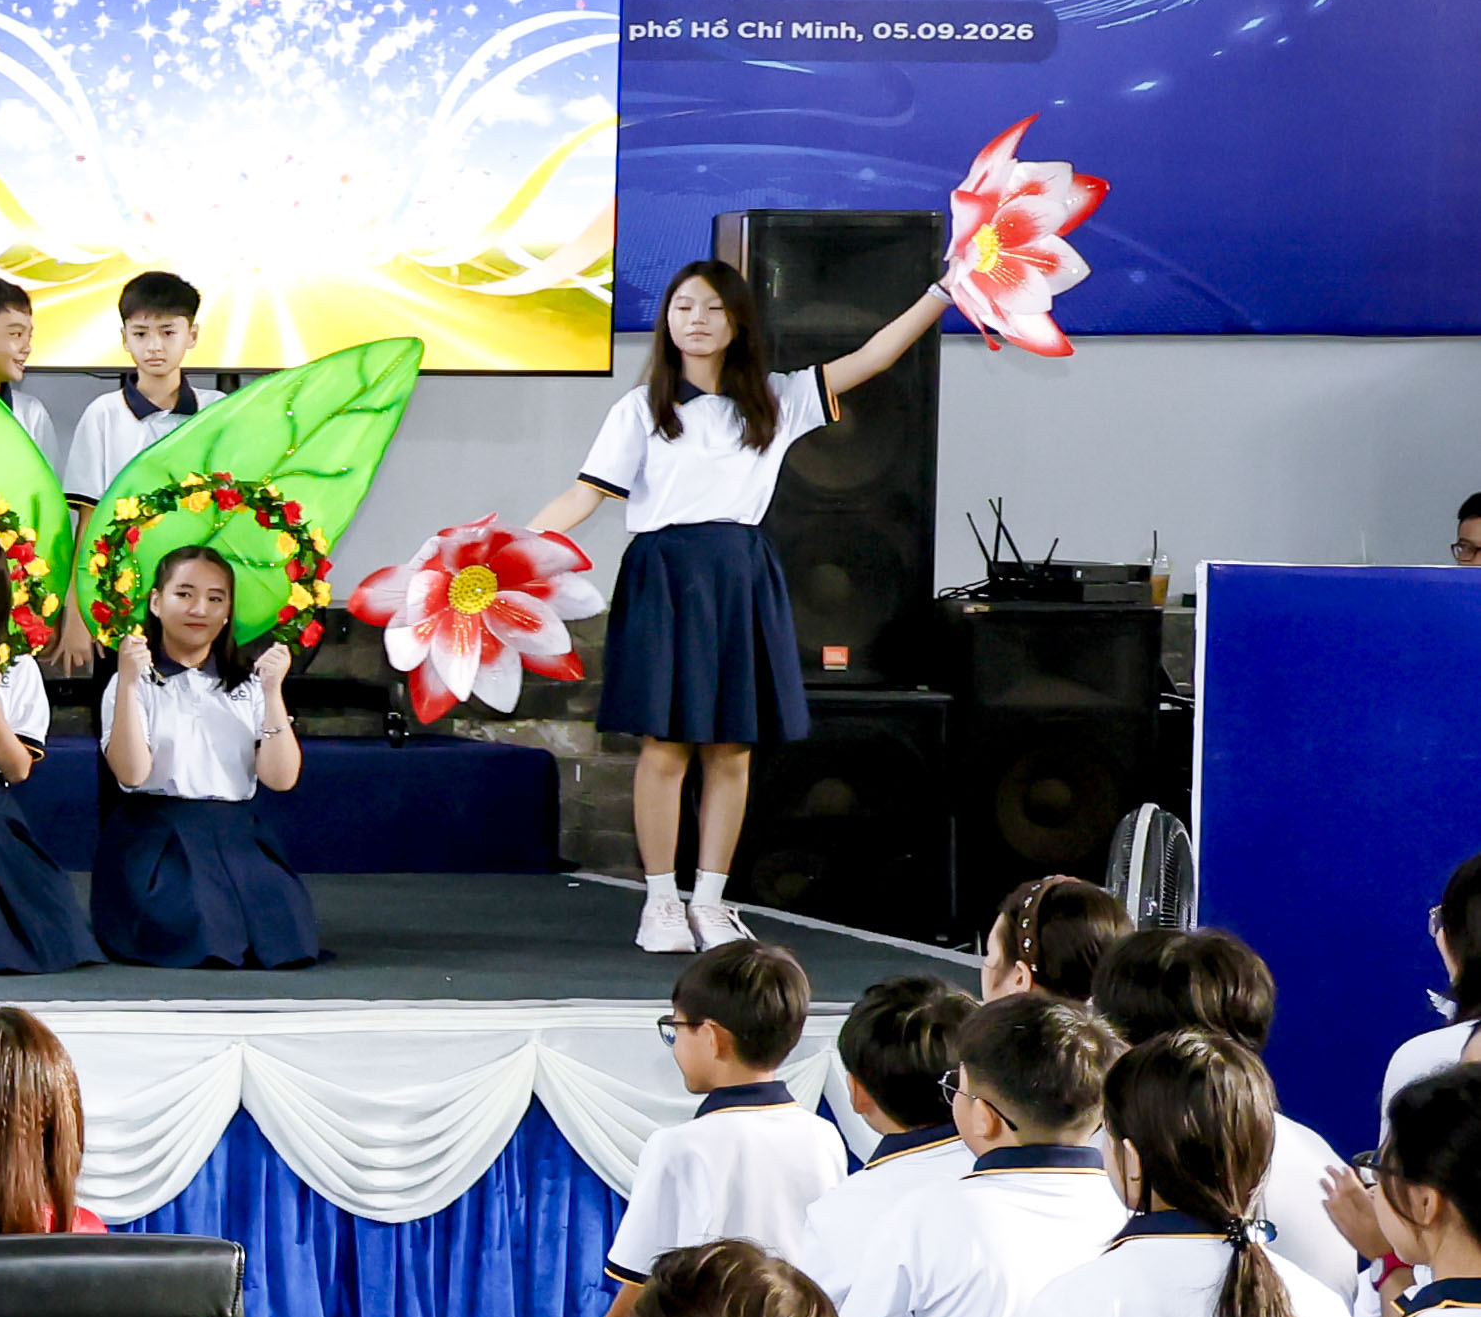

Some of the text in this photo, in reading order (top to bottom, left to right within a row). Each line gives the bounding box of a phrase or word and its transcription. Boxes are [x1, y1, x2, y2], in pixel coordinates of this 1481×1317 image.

[629, 18, 1035, 43] phố Hồ Chí Minh, 05.09.2026
